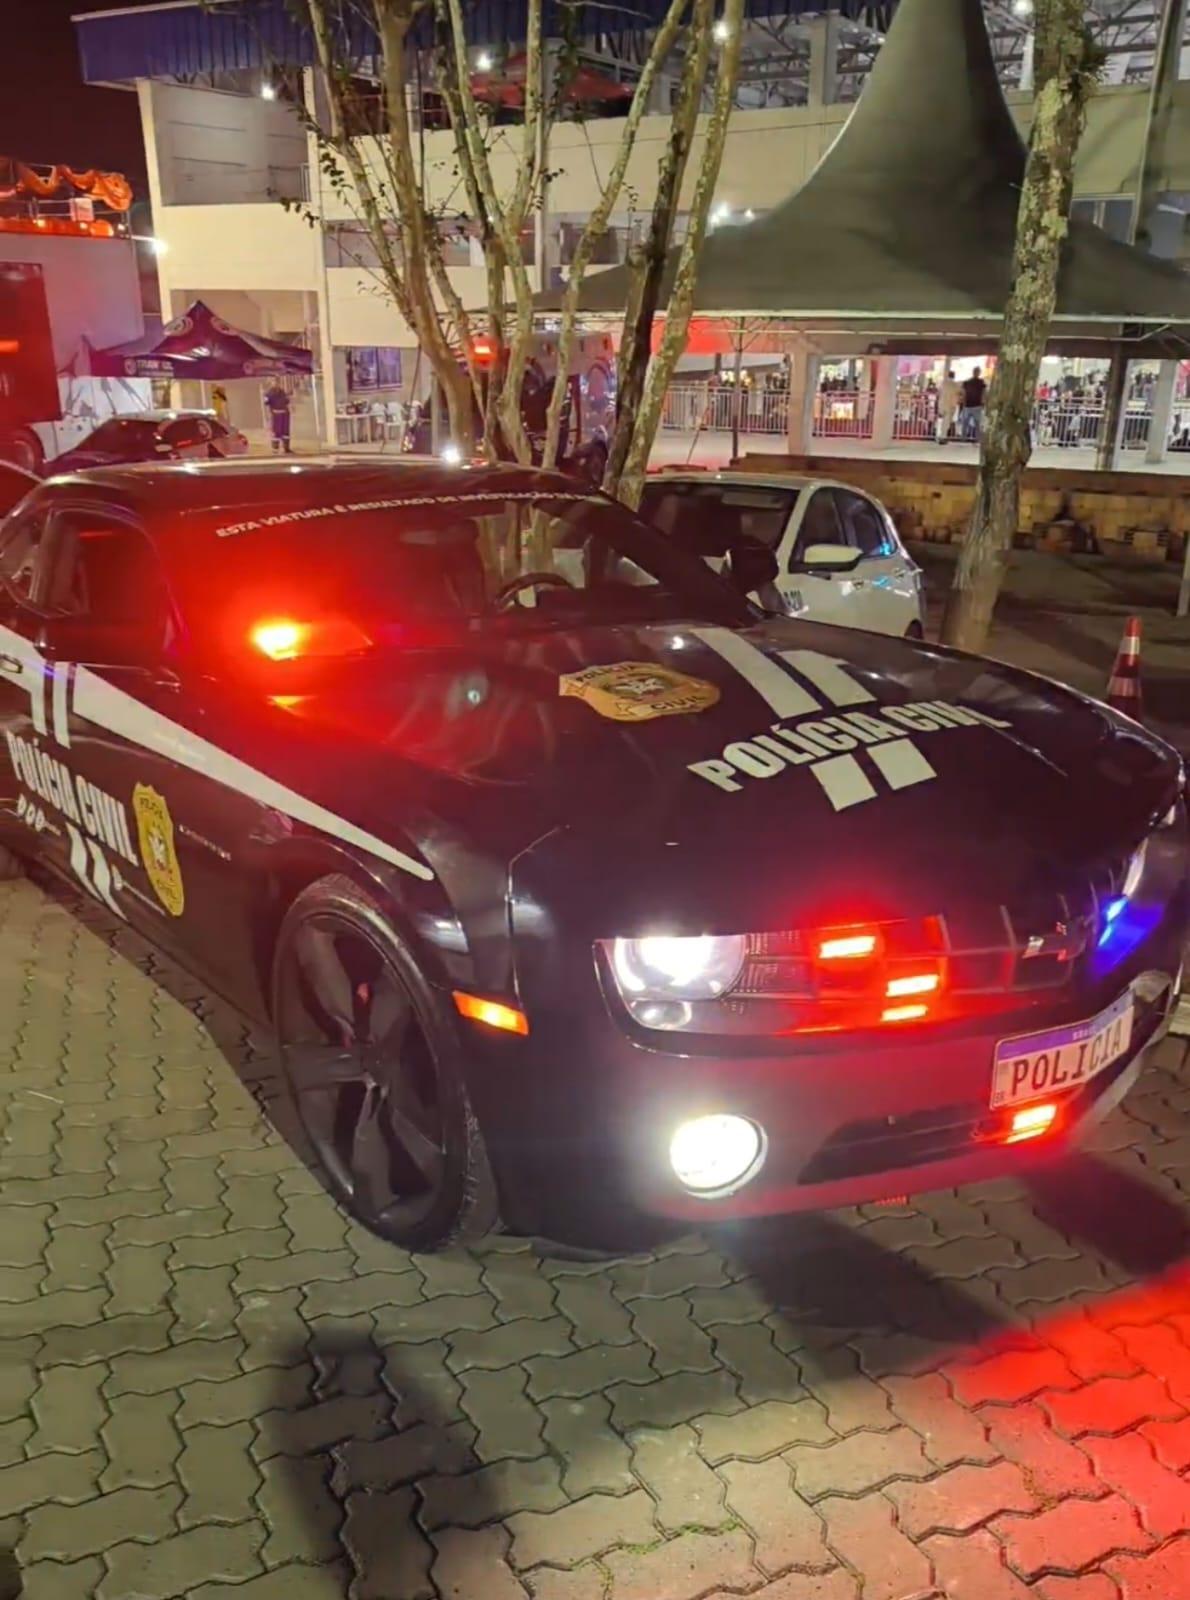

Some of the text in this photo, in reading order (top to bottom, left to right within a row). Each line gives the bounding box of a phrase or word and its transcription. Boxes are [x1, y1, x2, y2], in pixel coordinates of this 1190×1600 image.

[216, 521, 261, 537] ESTA
[260, 507, 335, 526] VIATURA
[687, 700, 1013, 792] POLÍCIA CIVIL
[6, 730, 82, 826] POLÍCIA
[75, 775, 139, 867] CIVIL
[1012, 1018, 1122, 1096] POLICIA
